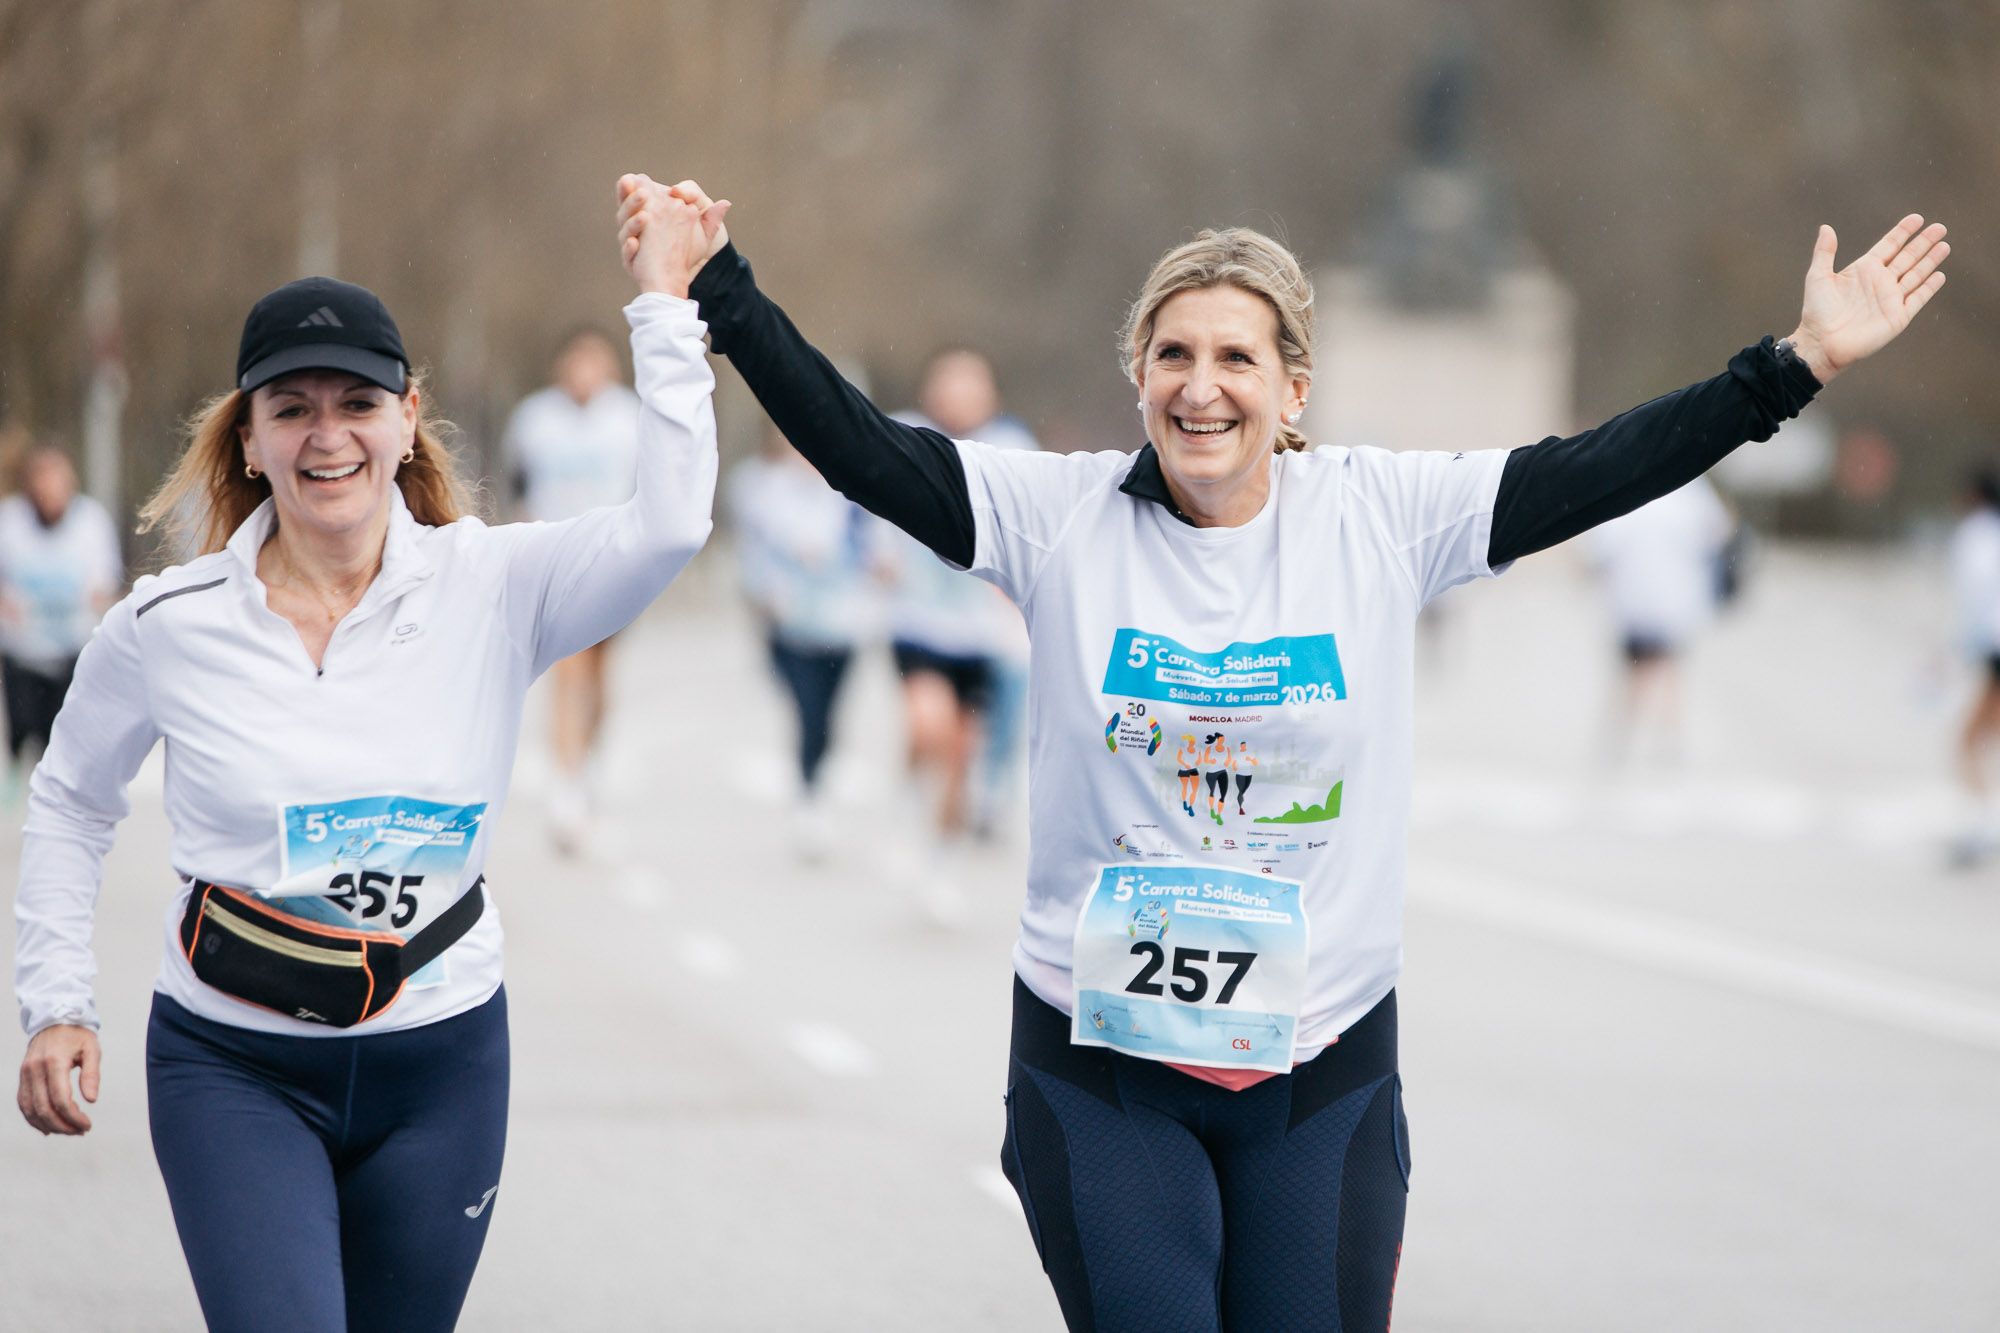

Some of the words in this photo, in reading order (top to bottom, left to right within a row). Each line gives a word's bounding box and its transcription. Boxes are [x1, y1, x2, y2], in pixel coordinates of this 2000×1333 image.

[1154, 647, 1221, 676] Carrera
[1169, 687, 1212, 702] Sábado
[1214, 692, 1222, 702] 7
[1225, 691, 1240, 702] de
[1242, 692, 1278, 702] marzo
[1281, 682, 1337, 705] 2026
[1127, 702, 1146, 717] 20
[1189, 715, 1233, 723] MONCLOA
[1235, 714, 1263, 723] MADRID
[322, 870, 425, 929] 255
[1139, 881, 1199, 897] Carrera
[1202, 882, 1271, 908] Solidaria
[1125, 940, 1258, 1005] 257
[1231, 1038, 1252, 1051] CSL
